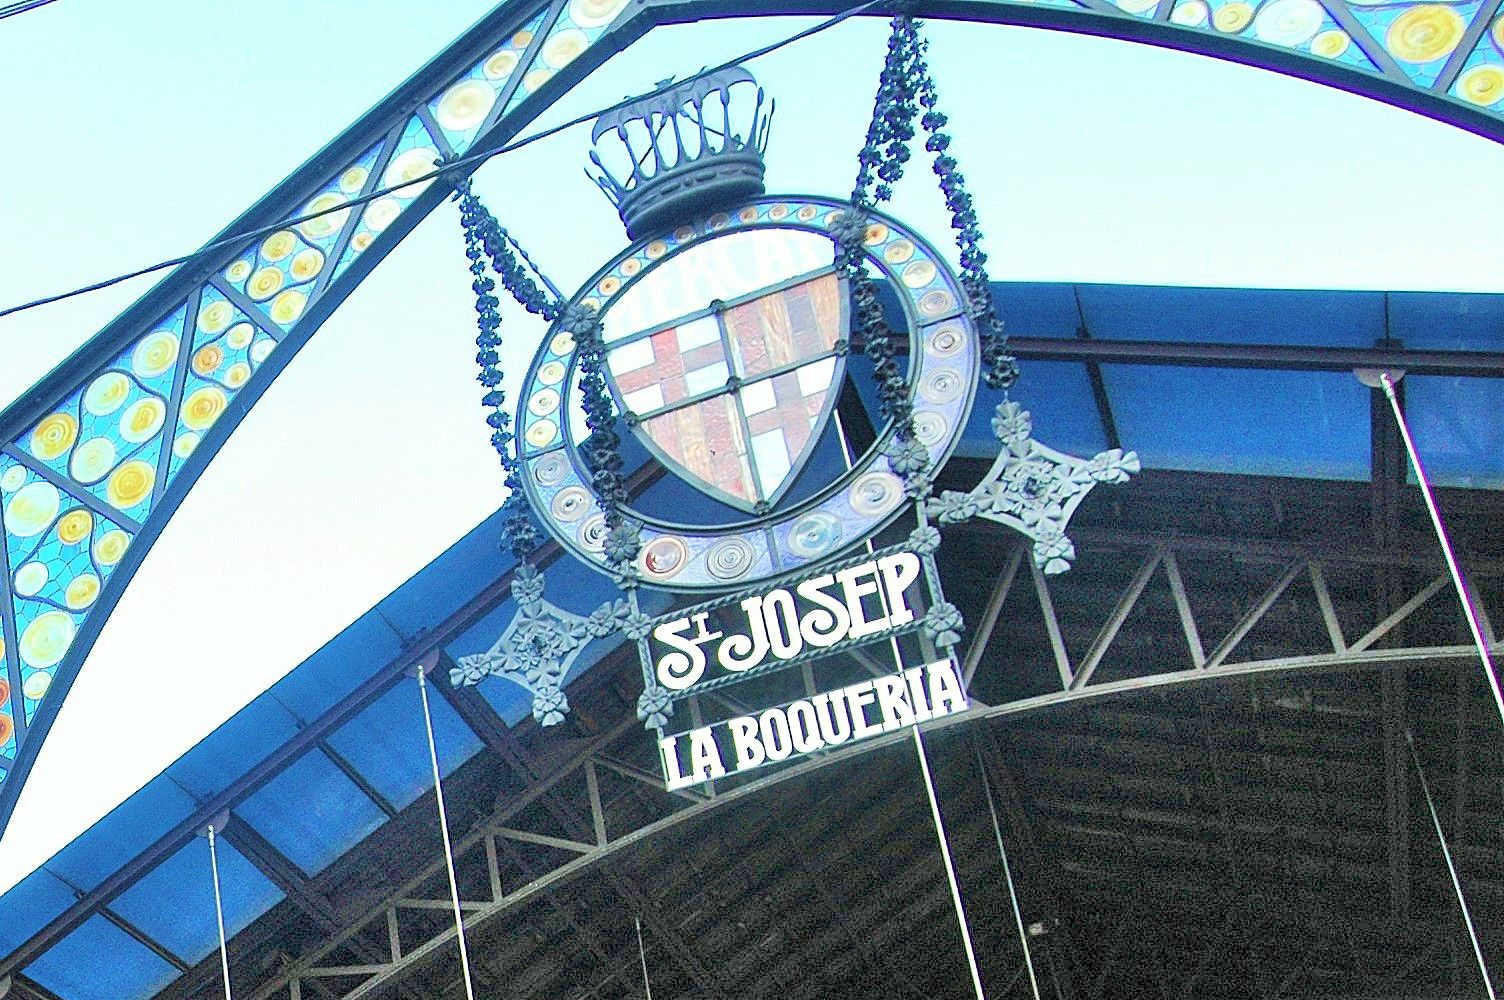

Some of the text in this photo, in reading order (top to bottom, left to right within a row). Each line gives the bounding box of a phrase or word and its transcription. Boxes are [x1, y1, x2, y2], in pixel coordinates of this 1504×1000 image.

[717, 551, 921, 672] JOSEP
[660, 658, 969, 791] LA BOQUERIA
